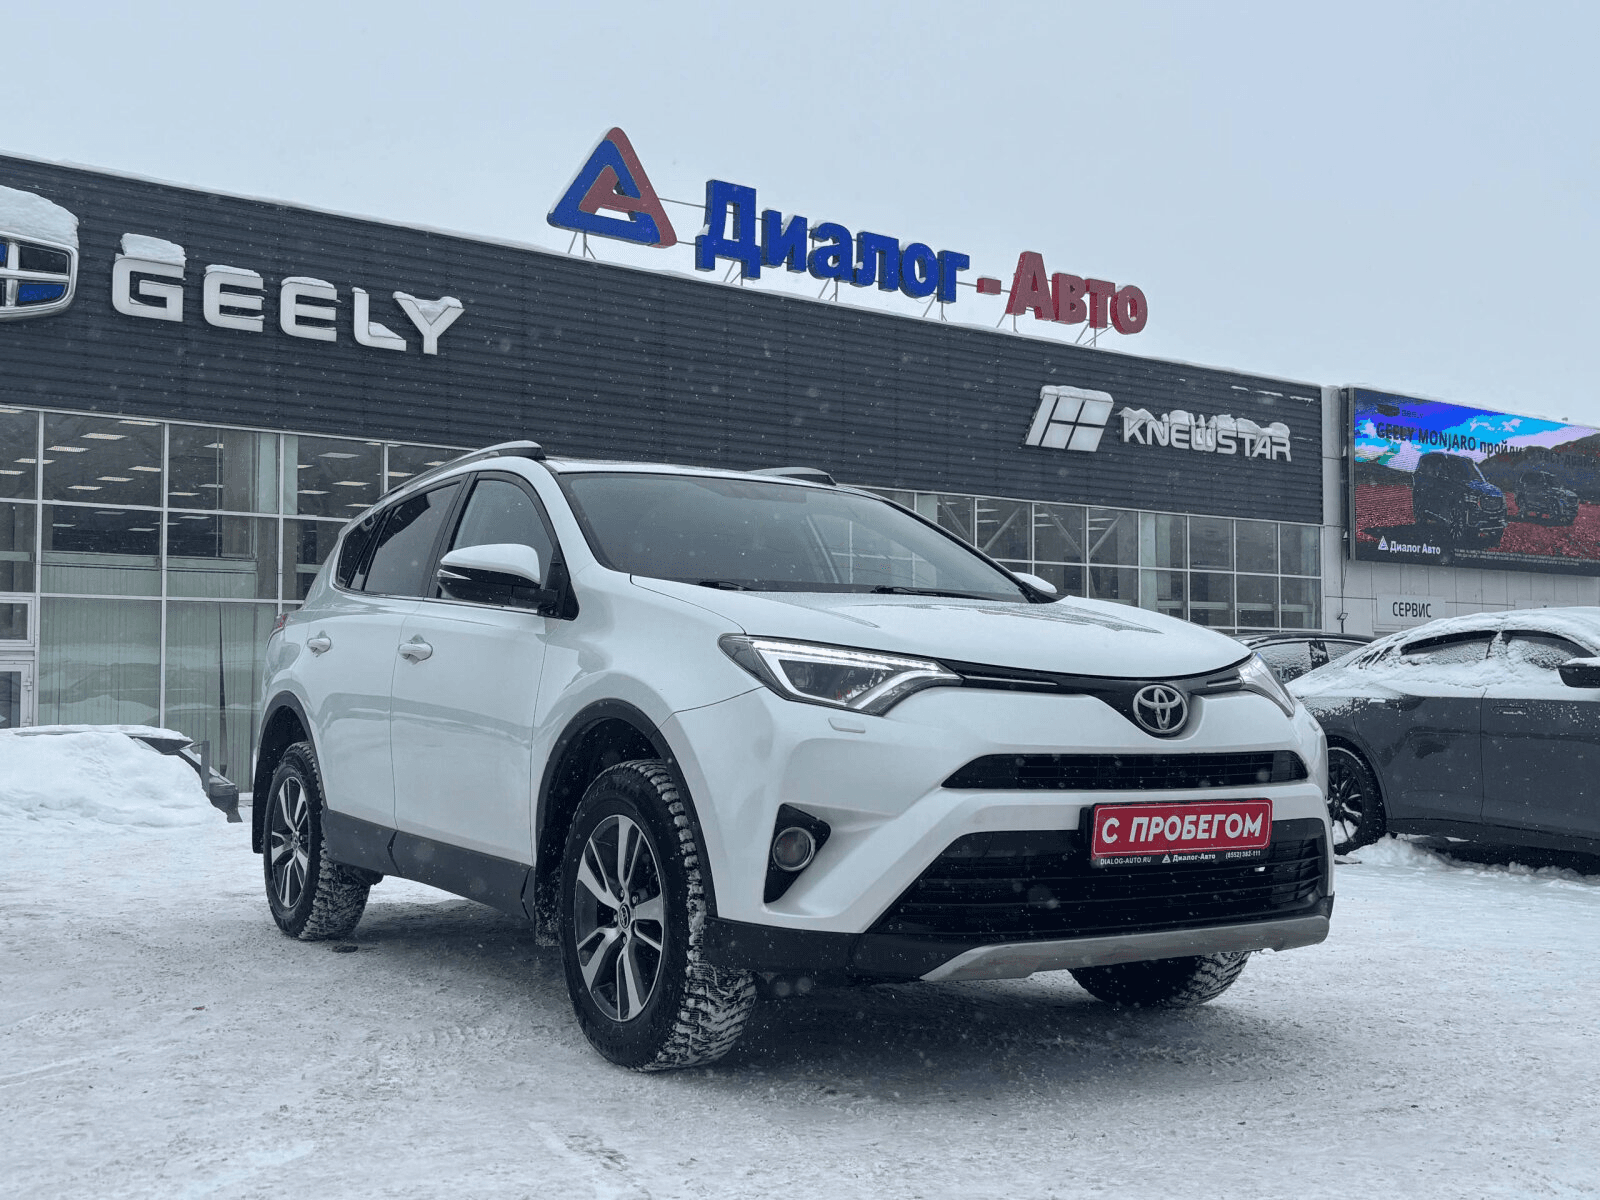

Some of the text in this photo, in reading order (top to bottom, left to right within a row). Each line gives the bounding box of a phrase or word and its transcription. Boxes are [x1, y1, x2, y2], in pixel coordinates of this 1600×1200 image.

[695, 179, 1148, 335] Диалог-Авто
[112, 251, 464, 356] GEELY
[1122, 415, 1292, 462] KNEWSTAR
[1418, 427, 1476, 451] MONJARO
[1389, 540, 1441, 555] Диалог Авто
[1392, 601, 1432, 618] СЕРВИС
[1101, 812, 1263, 844] С ПРОБЕГОМ
[1172, 853, 1216, 863] Диалог-Авто
